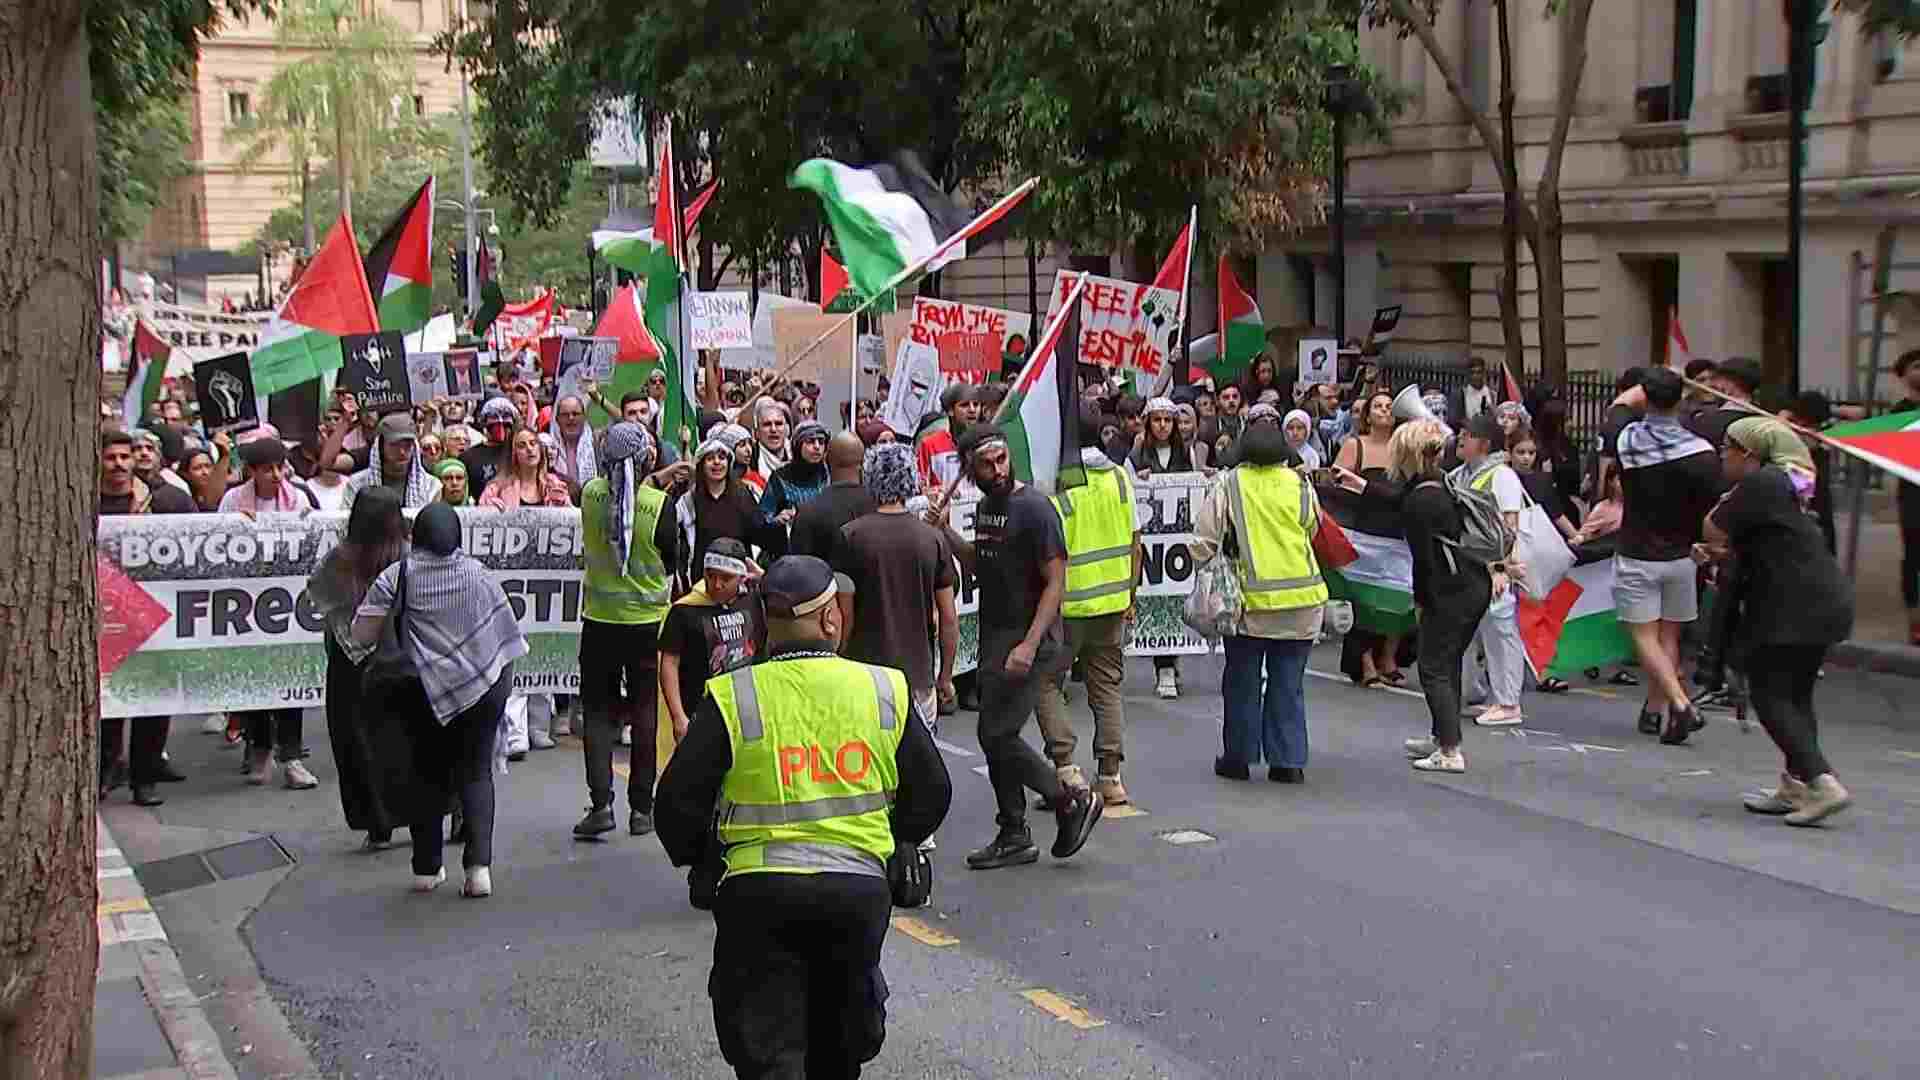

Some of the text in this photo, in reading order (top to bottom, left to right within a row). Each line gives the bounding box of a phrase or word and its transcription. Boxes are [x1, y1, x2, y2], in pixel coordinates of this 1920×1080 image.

[915, 300, 1007, 334] FROM THE
[121, 531, 306, 567] BOYCOTT
[720, 624, 743, 640] WITH
[779, 739, 872, 786] PLO
